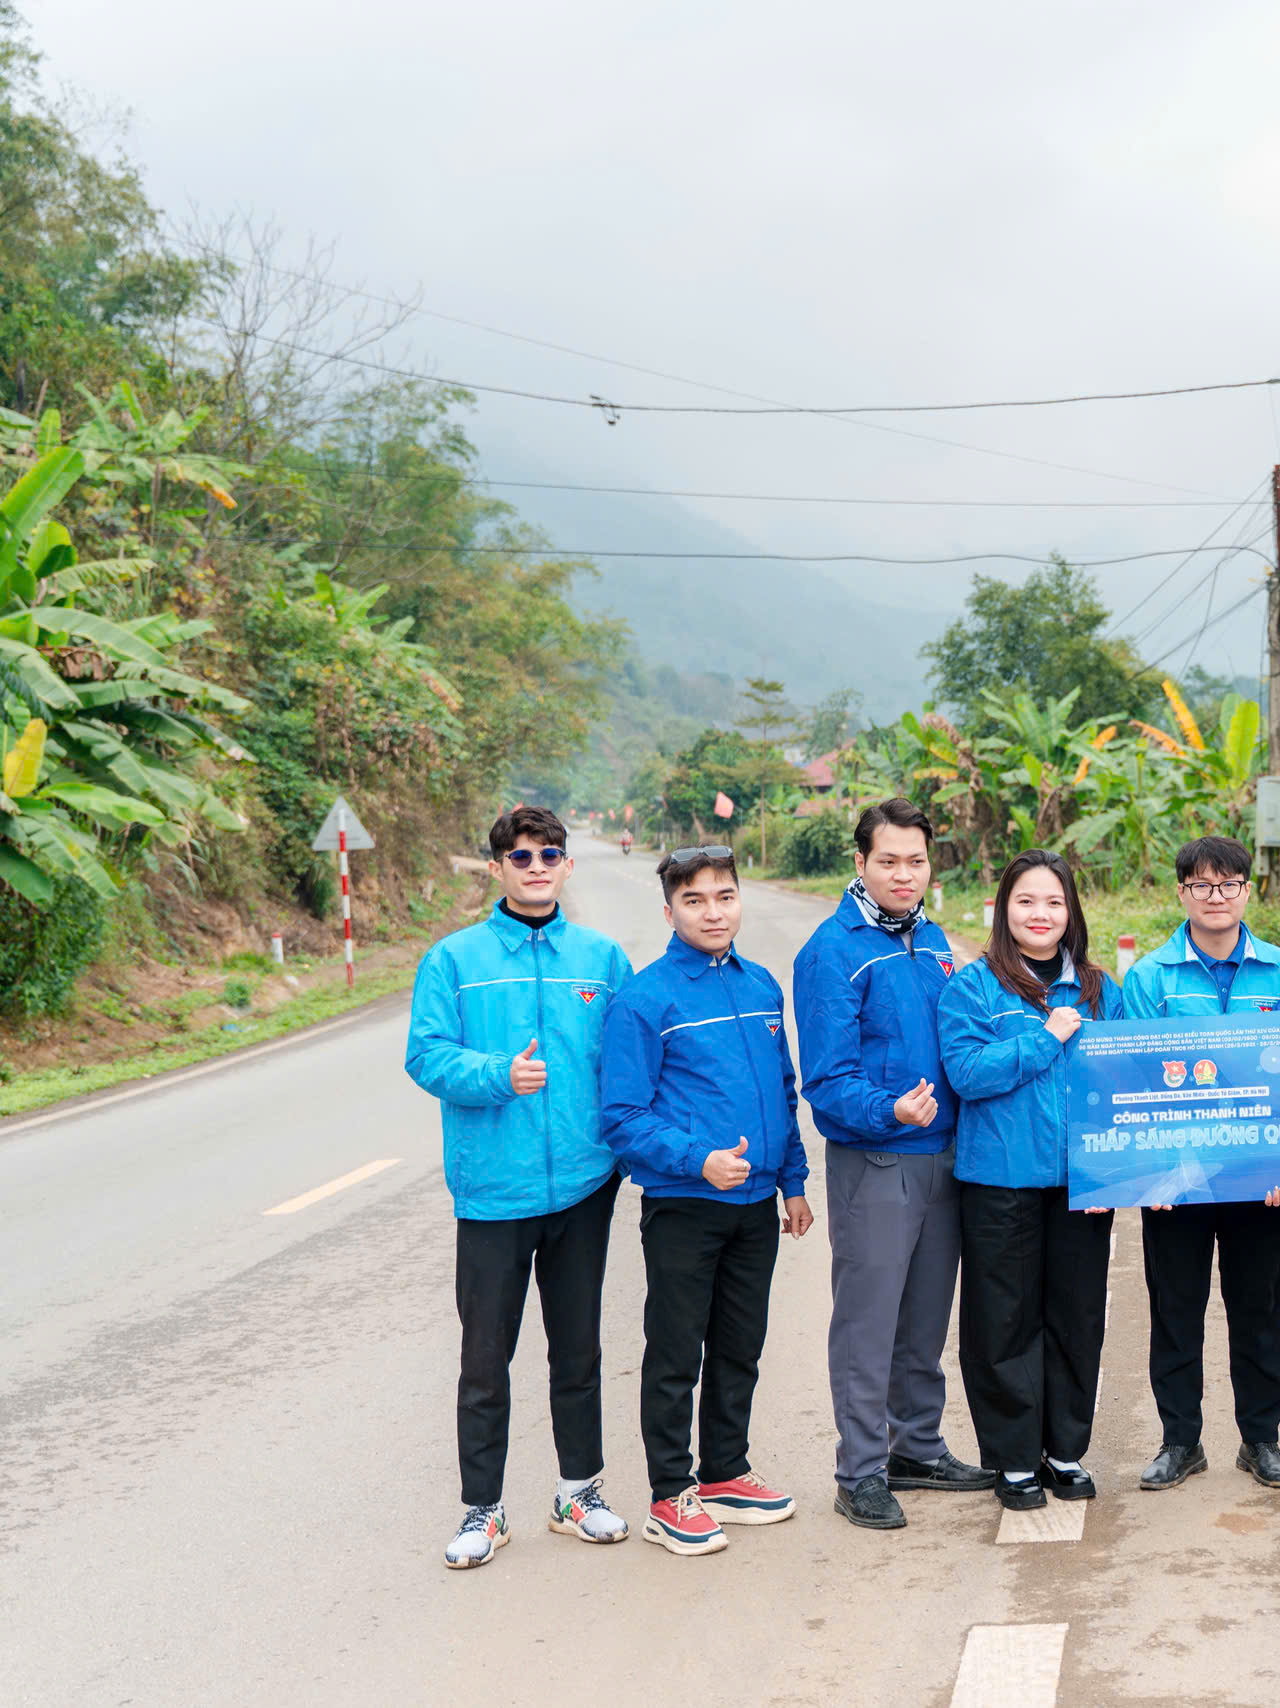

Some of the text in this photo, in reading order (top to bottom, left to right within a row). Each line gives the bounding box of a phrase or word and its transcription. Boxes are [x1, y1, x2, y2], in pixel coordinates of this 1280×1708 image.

[1112, 1105, 1272, 1125] CÔNG TRÌNH THANH NIÊN
[1134, 1126, 1188, 1150] SÁNG
[1190, 1122, 1260, 1148] ĐƯỜNG
